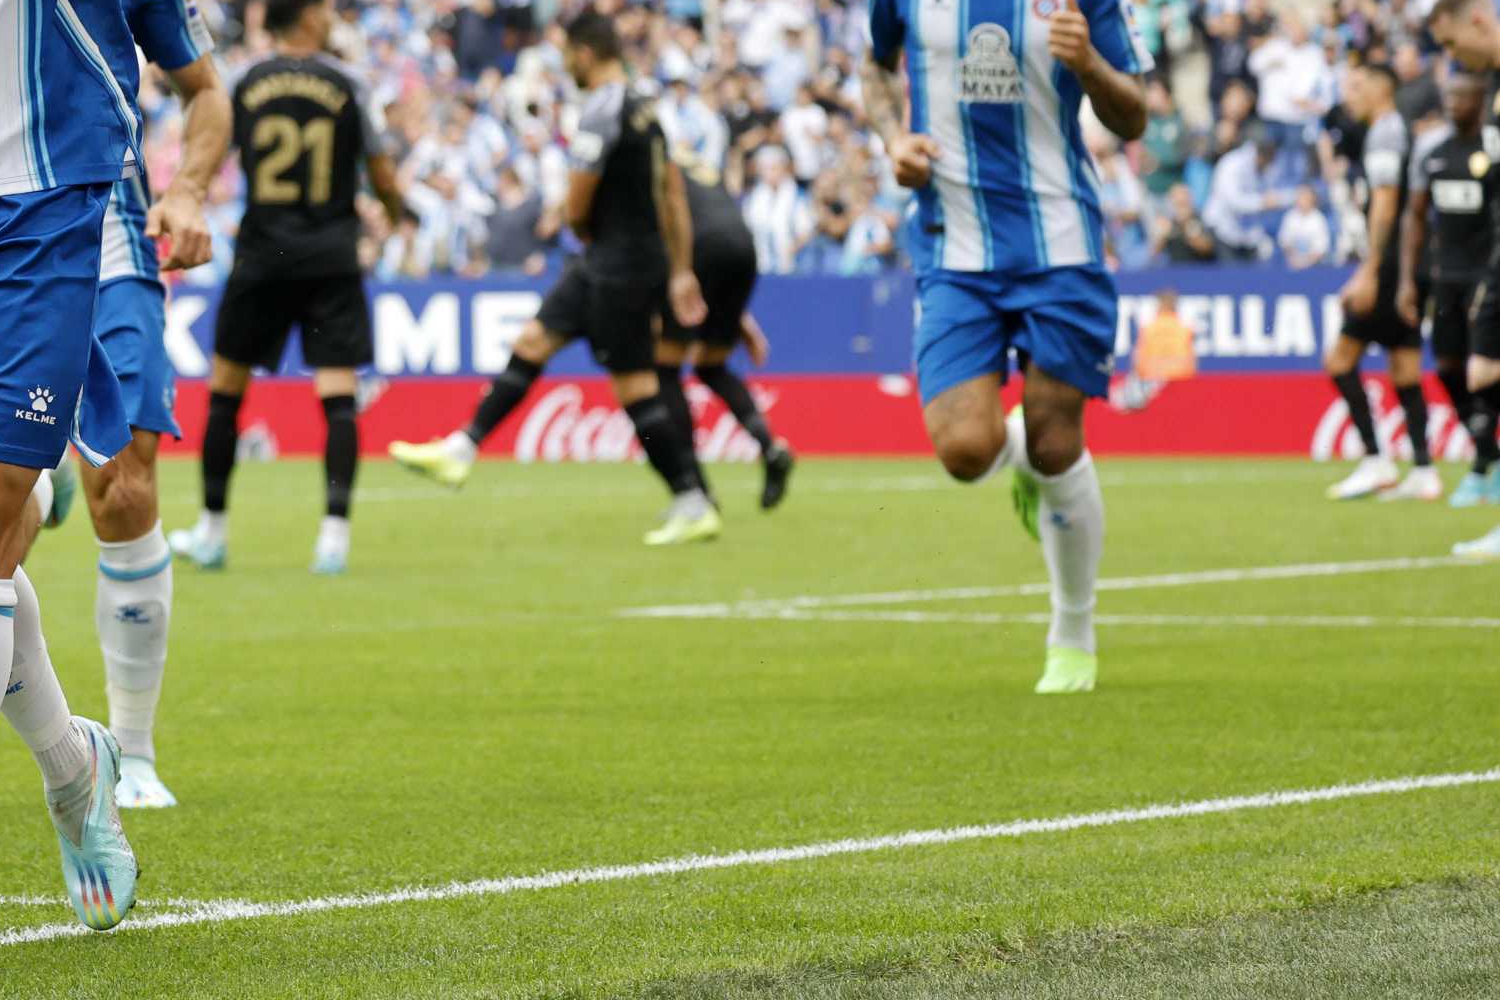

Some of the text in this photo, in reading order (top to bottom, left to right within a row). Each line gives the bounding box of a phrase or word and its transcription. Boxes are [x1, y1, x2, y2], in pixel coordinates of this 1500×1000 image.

[962, 81, 1020, 96] MAYA
[252, 114, 335, 204] 21
[15, 409, 56, 425] KELME
